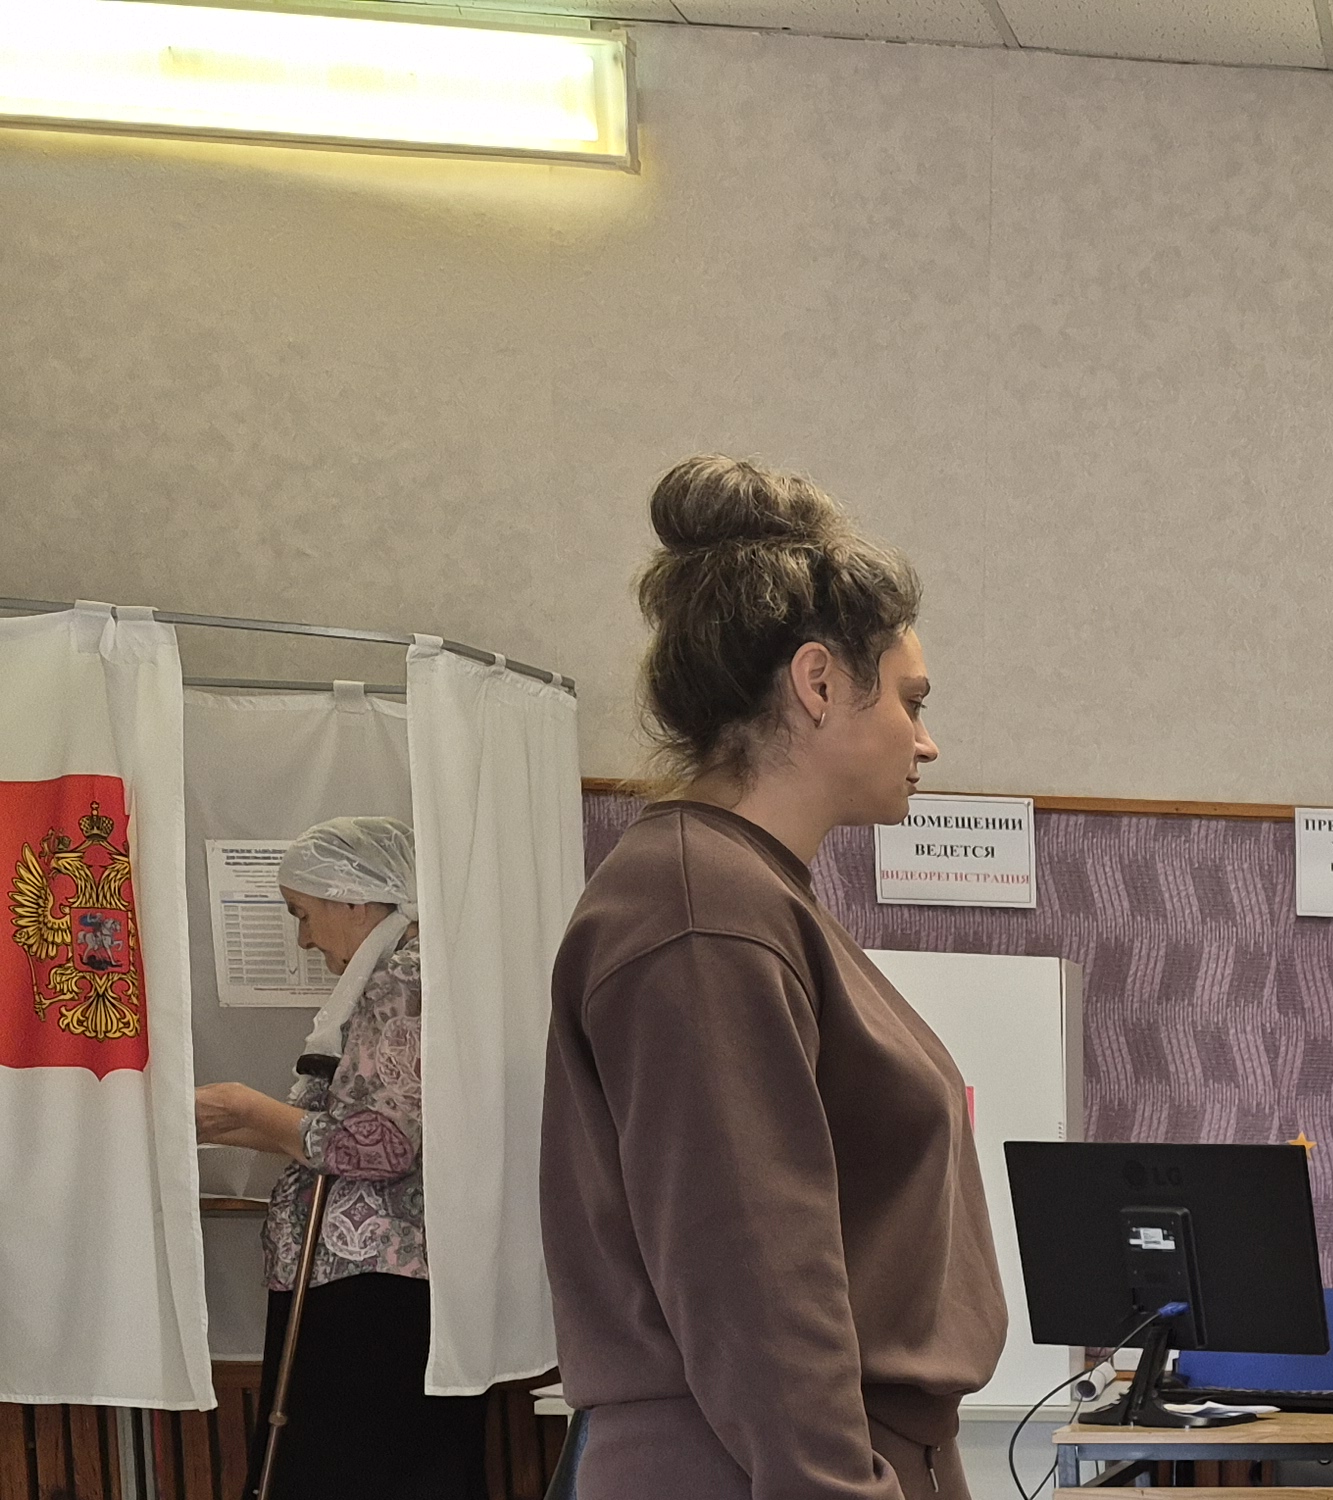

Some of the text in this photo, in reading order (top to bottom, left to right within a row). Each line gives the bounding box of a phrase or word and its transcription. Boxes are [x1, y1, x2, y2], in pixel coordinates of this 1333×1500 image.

[901, 814, 1023, 831] ПОМЕЩЕНИИ
[915, 843, 995, 859] ВЕДЕТСЯ
[881, 869, 1029, 885] ВИДЕОРЕГИСТРАЦИЯ
[1153, 1166, 1183, 1186] LG
